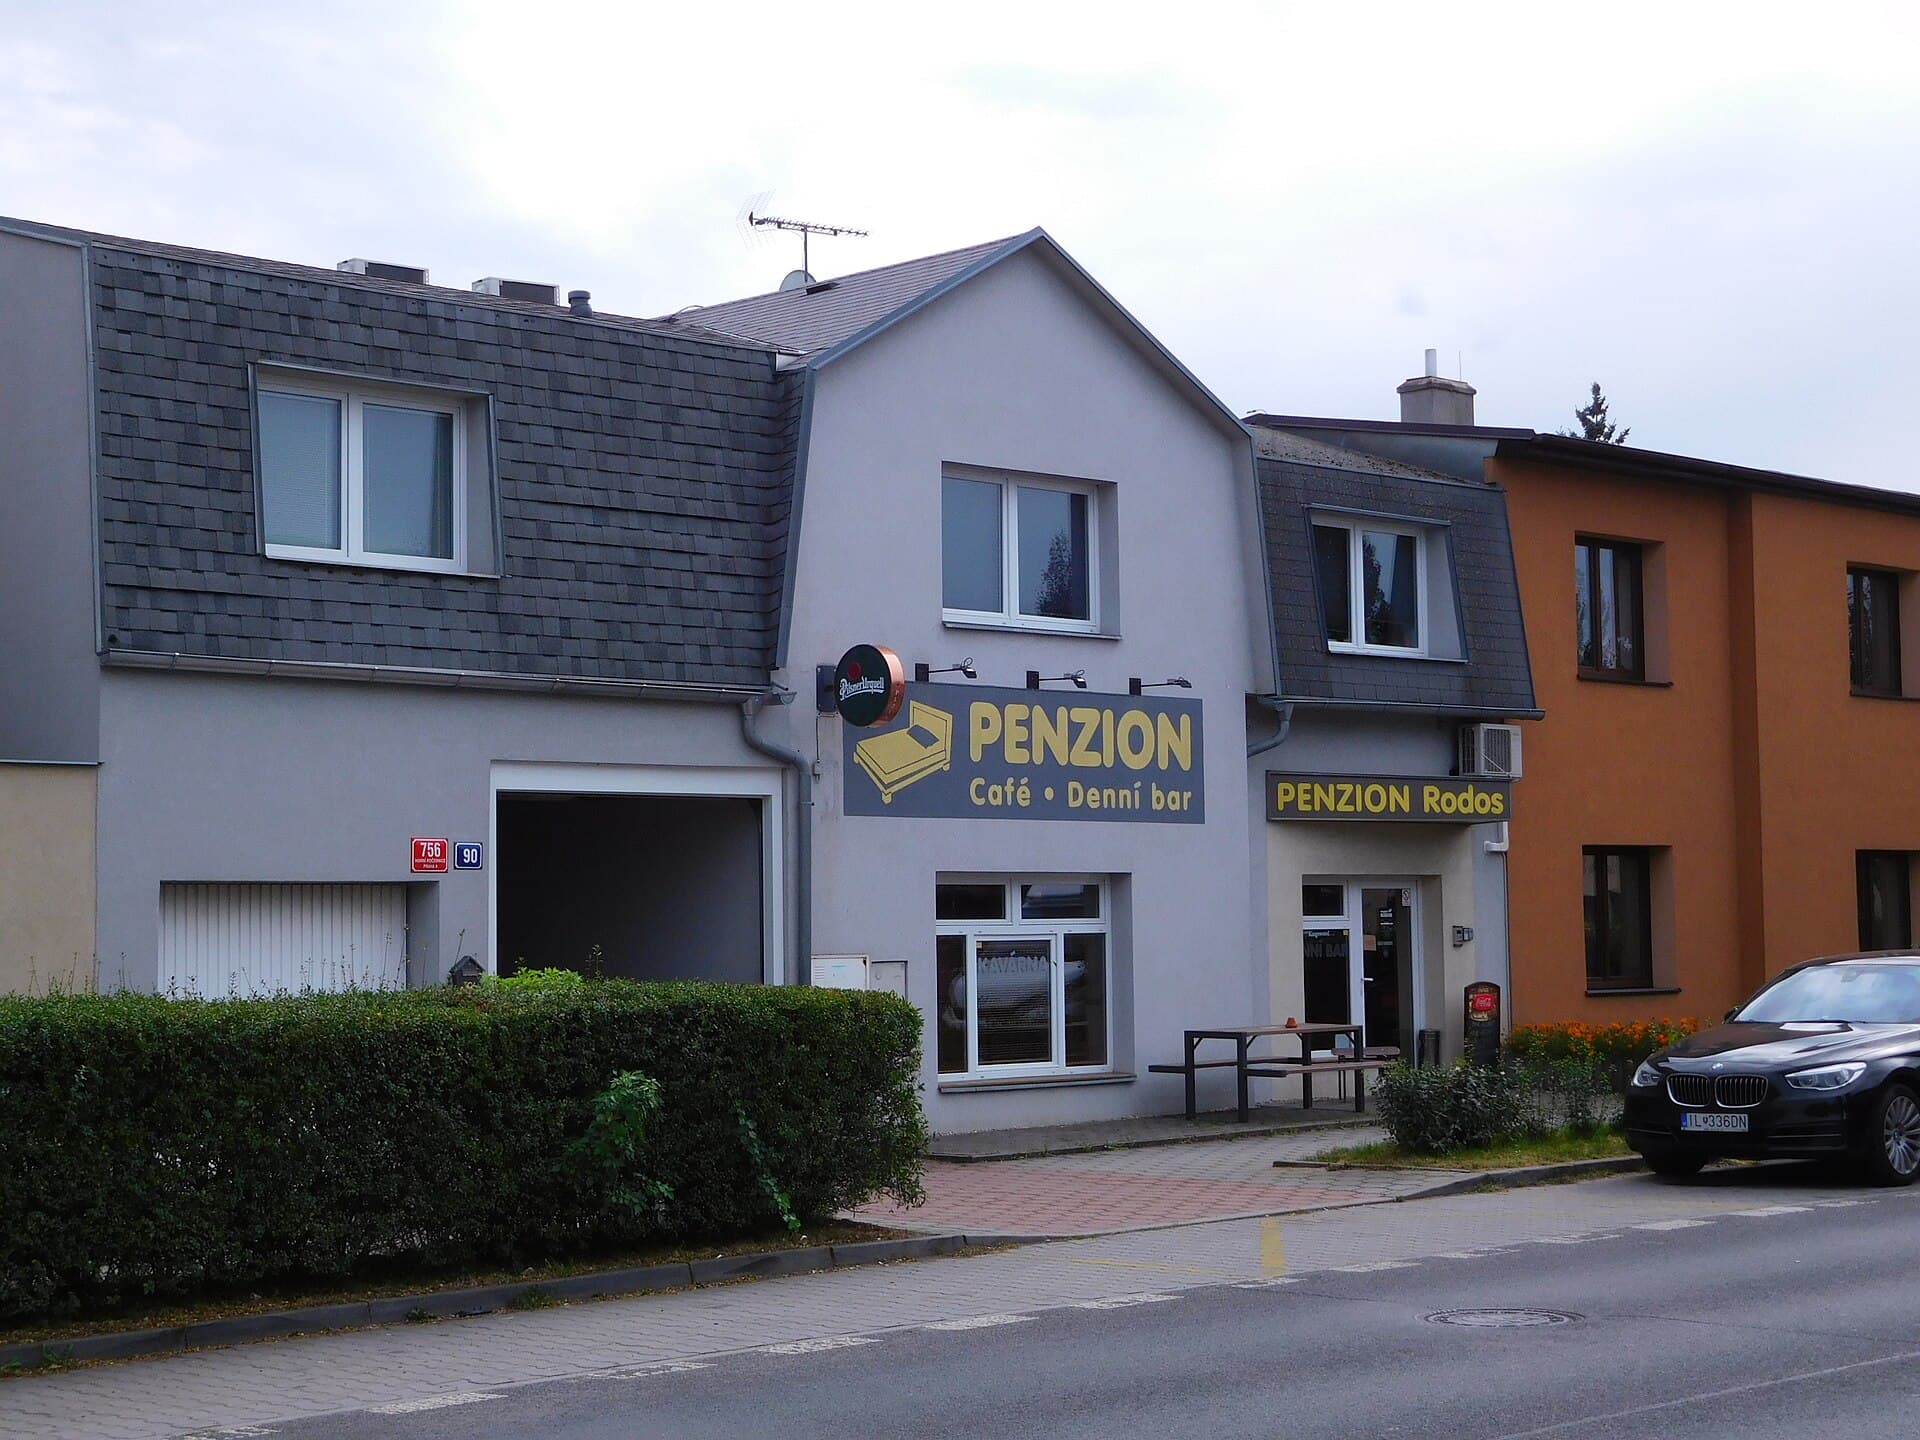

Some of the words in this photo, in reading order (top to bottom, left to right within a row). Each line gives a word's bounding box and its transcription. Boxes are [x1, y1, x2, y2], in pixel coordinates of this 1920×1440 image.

[840, 678, 863, 700] Pilsner
[862, 676, 885, 694] Urquell
[969, 701, 1192, 772] PENZION
[969, 776, 1031, 807] Café
[1068, 781, 1141, 810] Denní
[1151, 783, 1192, 811] bar
[1277, 782, 1410, 813] PENZION
[1423, 784, 1504, 815] Rodos
[420, 842, 441, 858] 756
[463, 848, 478, 863] 90
[1708, 1114, 1747, 1128] 336DN
